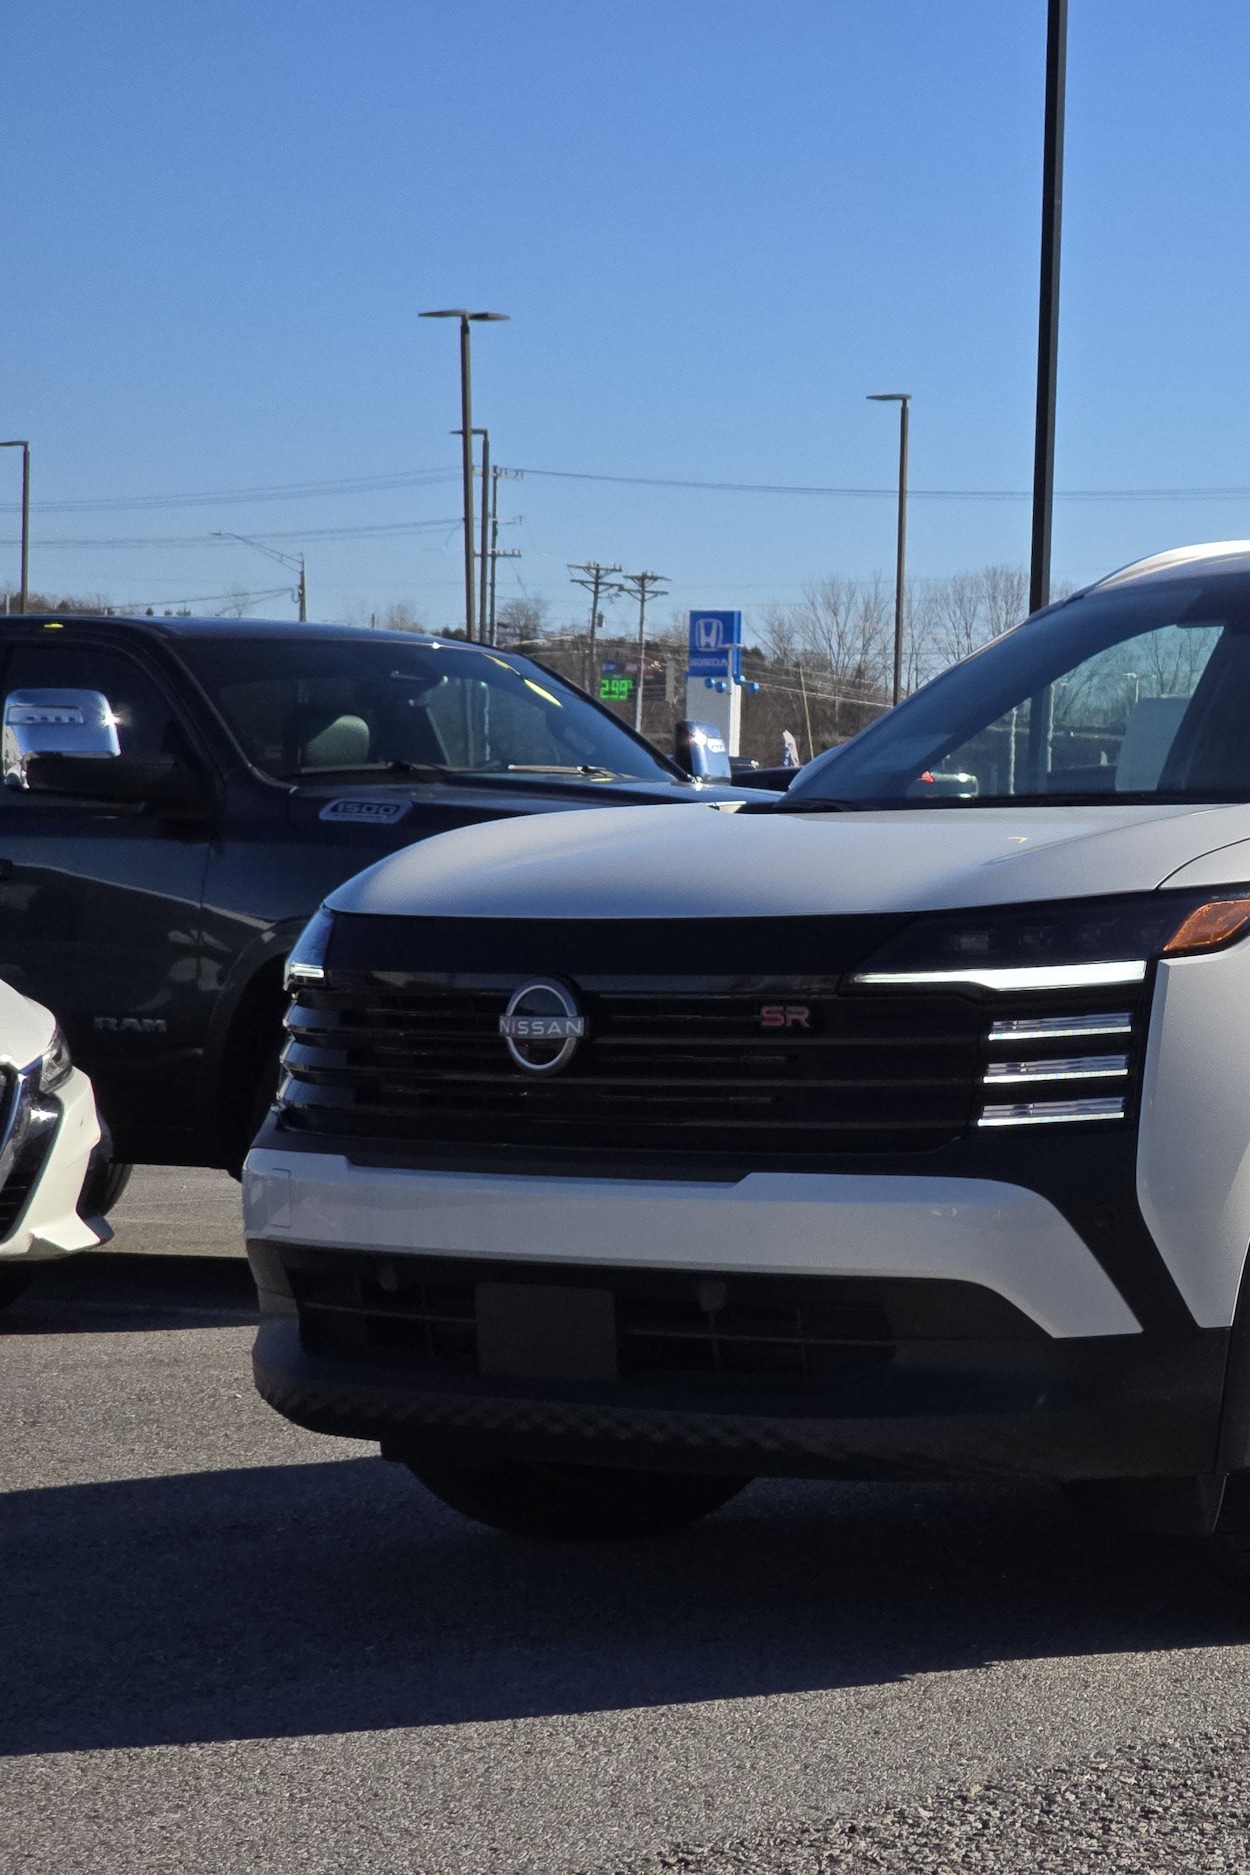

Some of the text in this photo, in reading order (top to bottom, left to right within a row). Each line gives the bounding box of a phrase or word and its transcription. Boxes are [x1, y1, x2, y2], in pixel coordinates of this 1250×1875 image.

[336, 801, 397, 815] 1500
[760, 1005, 810, 1027] SR
[93, 1017, 167, 1032] RAM
[500, 1018, 583, 1036] NISSAN
